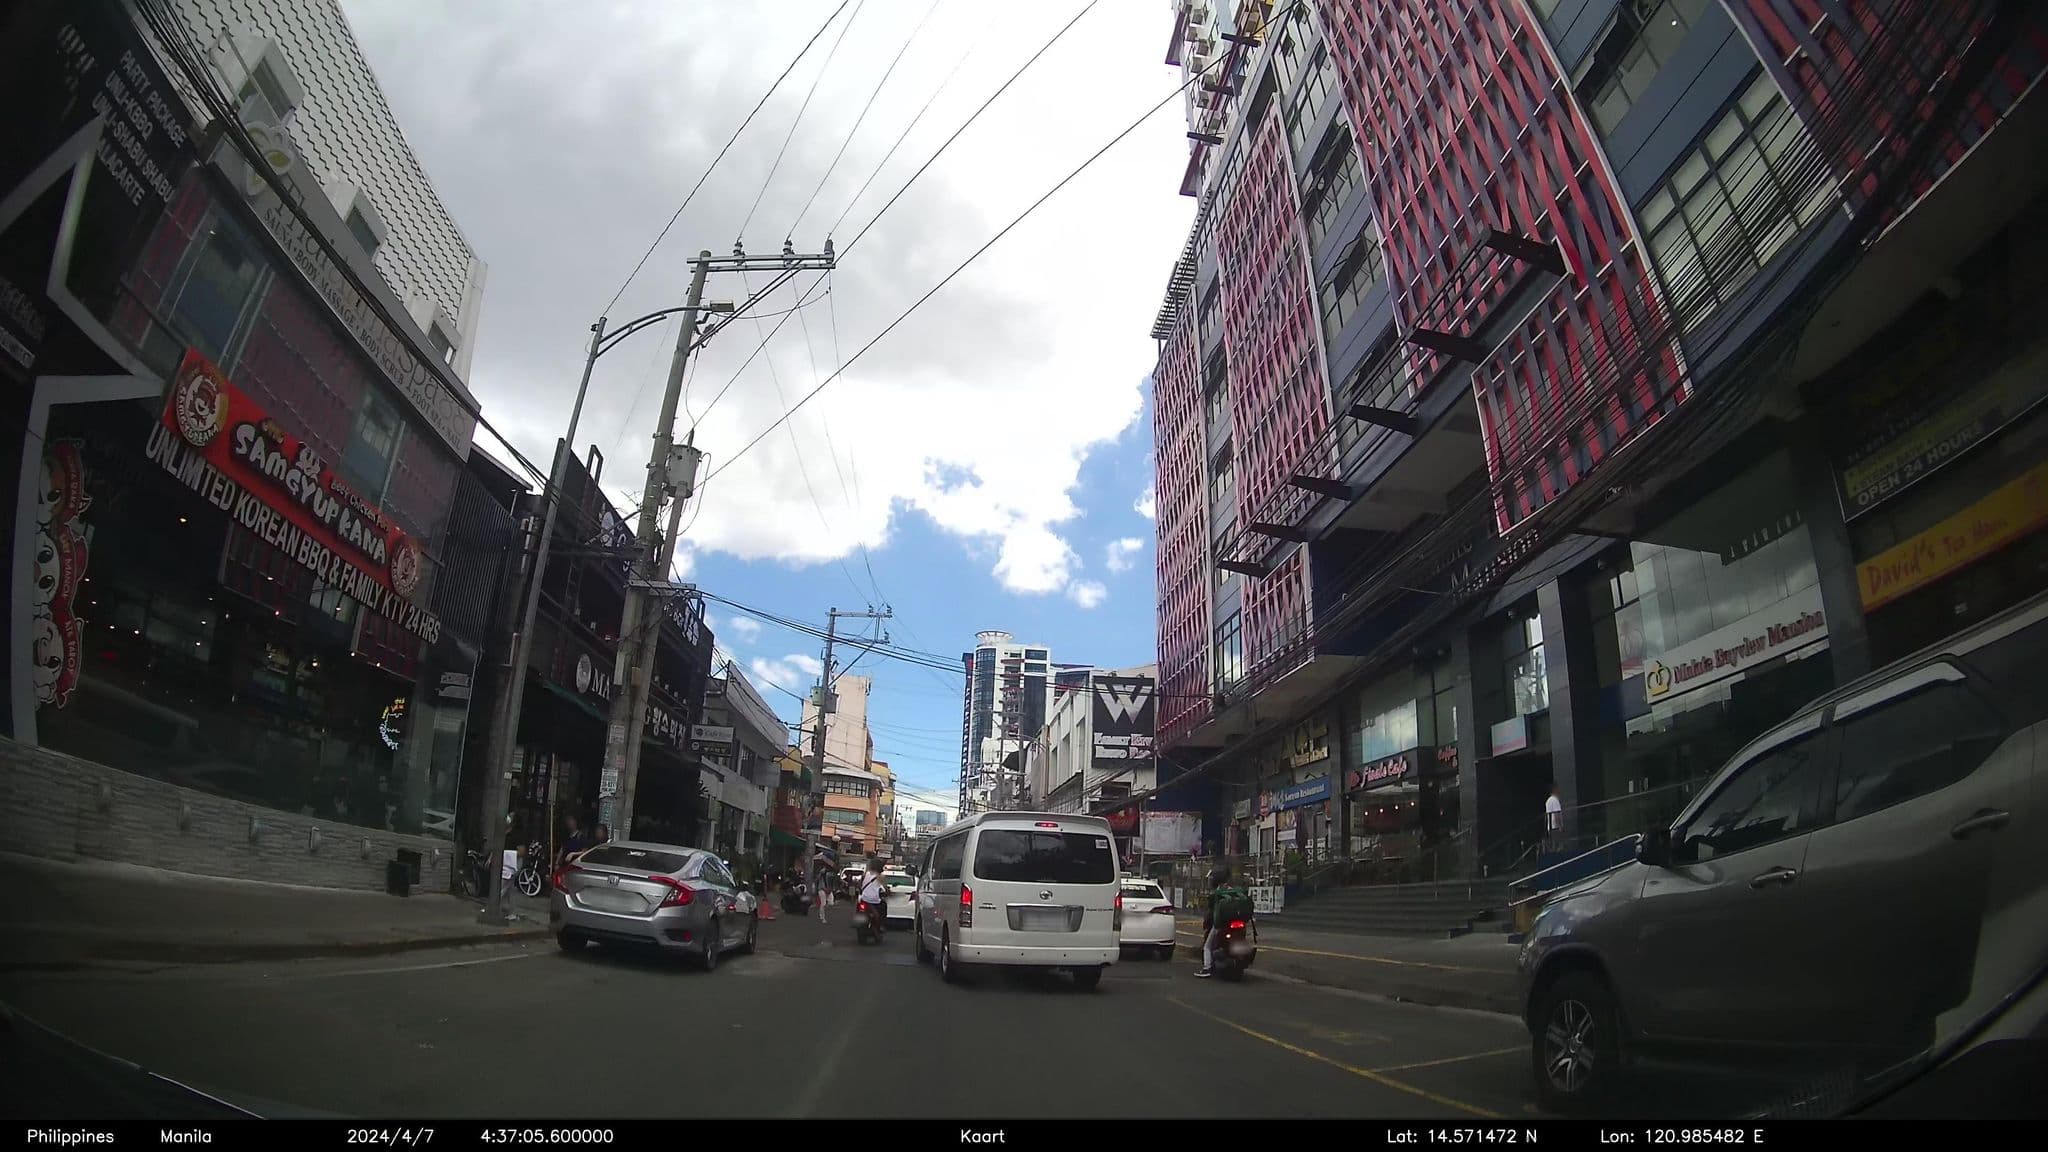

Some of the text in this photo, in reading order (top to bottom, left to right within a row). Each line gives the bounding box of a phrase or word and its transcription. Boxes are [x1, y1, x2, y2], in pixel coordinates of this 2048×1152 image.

[105, 70, 153, 141] UNLI-KBBQ
[120, 50, 187, 149] PARTY PACKAGE
[142, 158, 176, 203] SHABU
[263, 207, 293, 252] SAUNA
[360, 328, 380, 358] BODY
[381, 352, 405, 385] SCRUB
[410, 389, 432, 415] FOOT
[1857, 473, 1901, 506] OPEN
[1903, 458, 1924, 479] 24
[145, 423, 236, 514] UNLIMITED
[233, 493, 299, 561] KOREAN
[298, 533, 331, 581] BBQ
[328, 555, 341, 586] &
[340, 562, 384, 609] FAMILY
[1866, 537, 1936, 594] David's
[1766, 611, 1825, 647] Mansion
